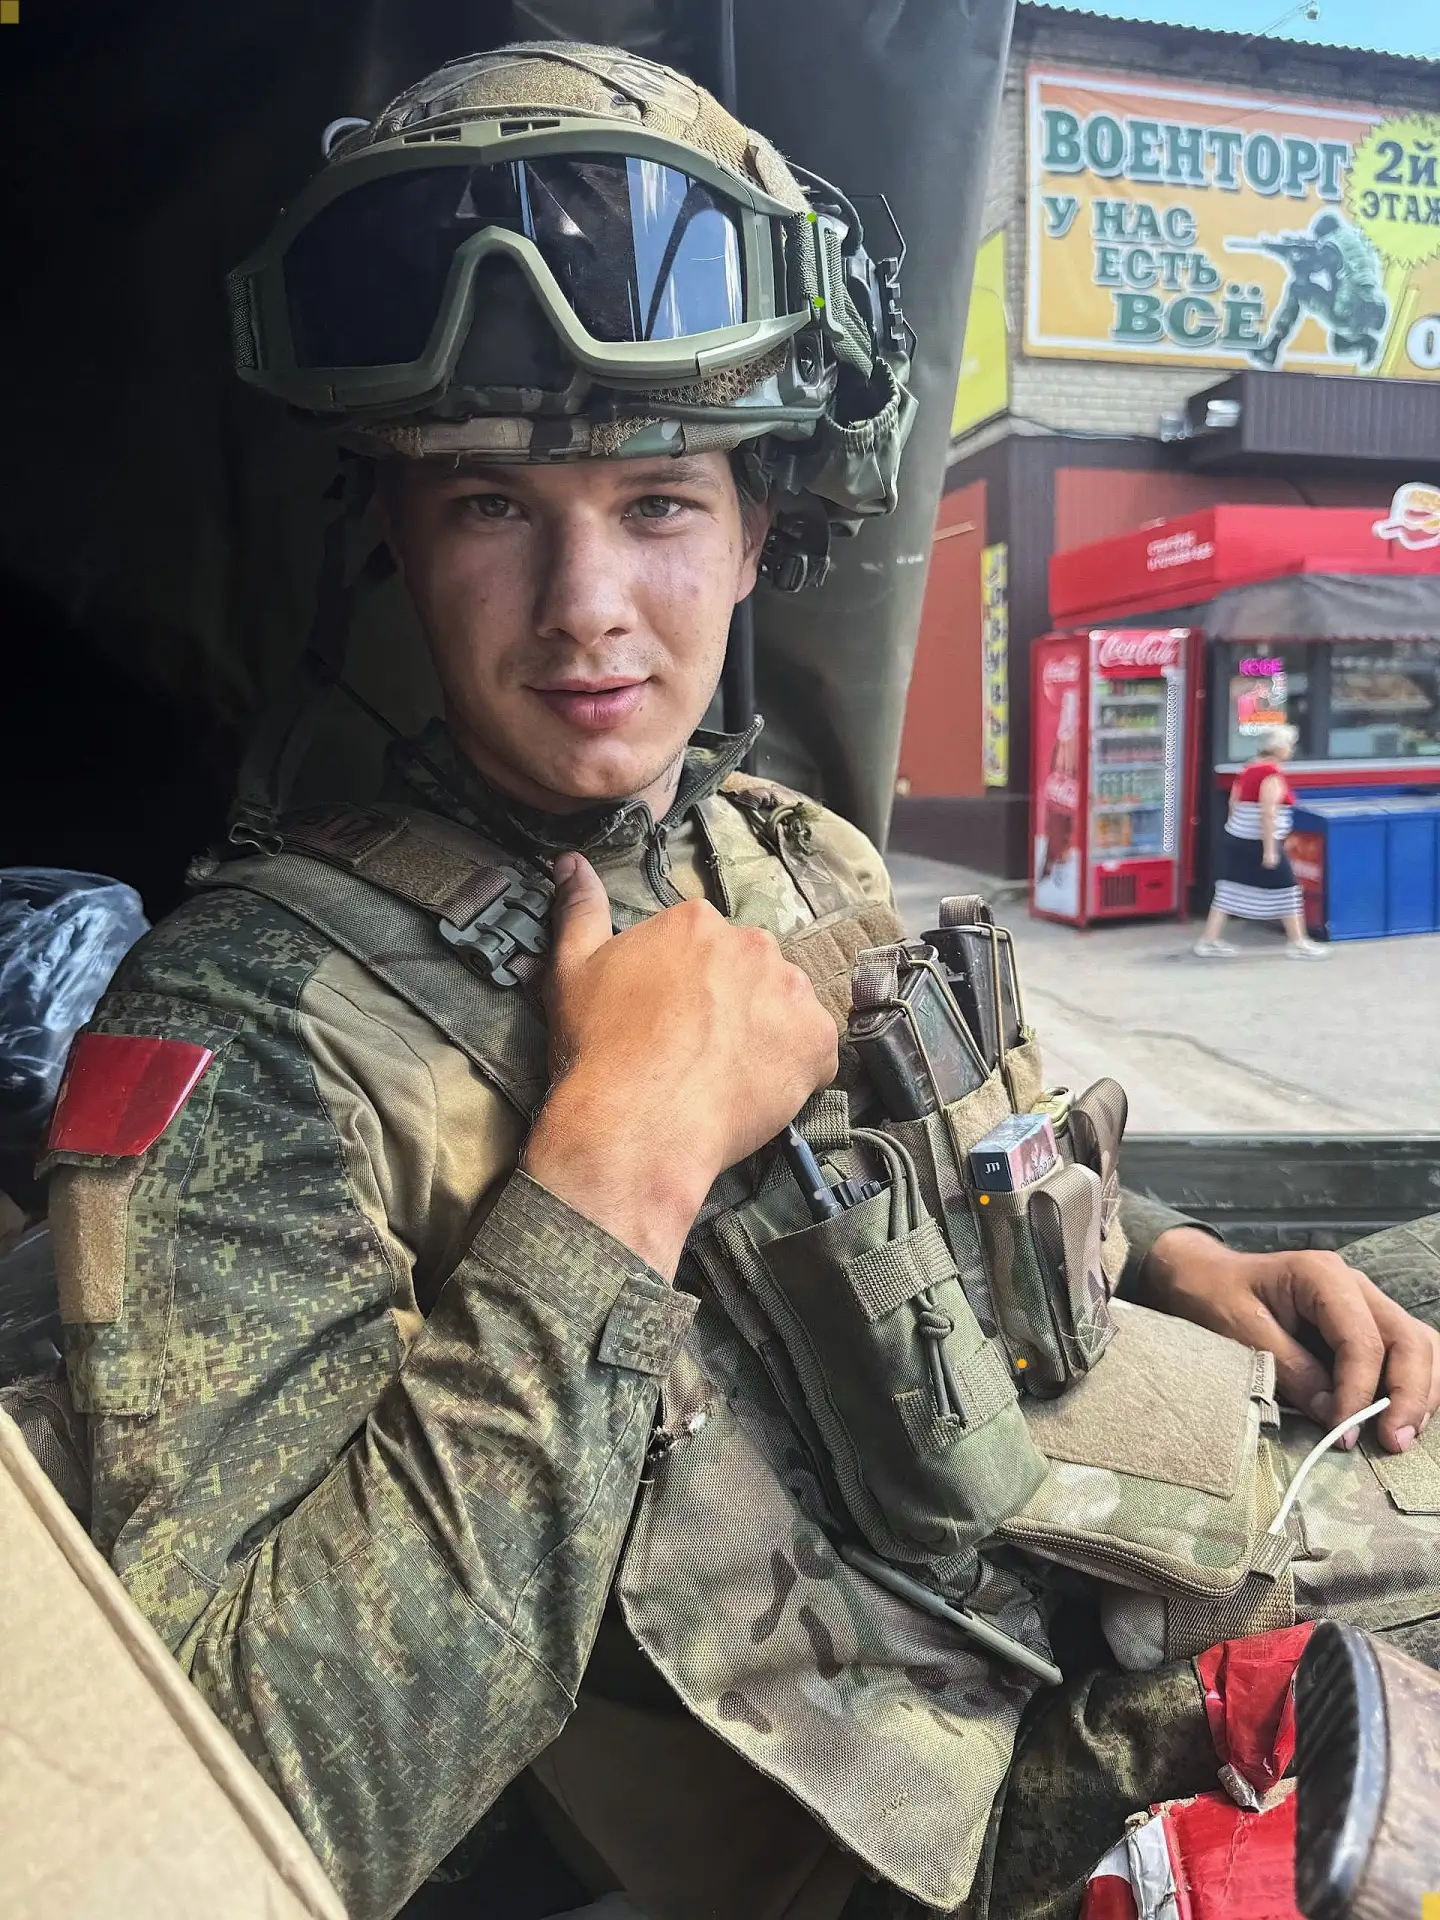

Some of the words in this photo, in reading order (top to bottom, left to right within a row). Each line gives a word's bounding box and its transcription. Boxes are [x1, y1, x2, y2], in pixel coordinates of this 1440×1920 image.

[1042, 108, 1350, 200] ВОЕНТОРГ
[1043, 196, 1077, 237] У
[1092, 201, 1196, 246] НАС
[1093, 246, 1220, 291] ЕСТЬ
[1112, 284, 1265, 348] ВСЁ
